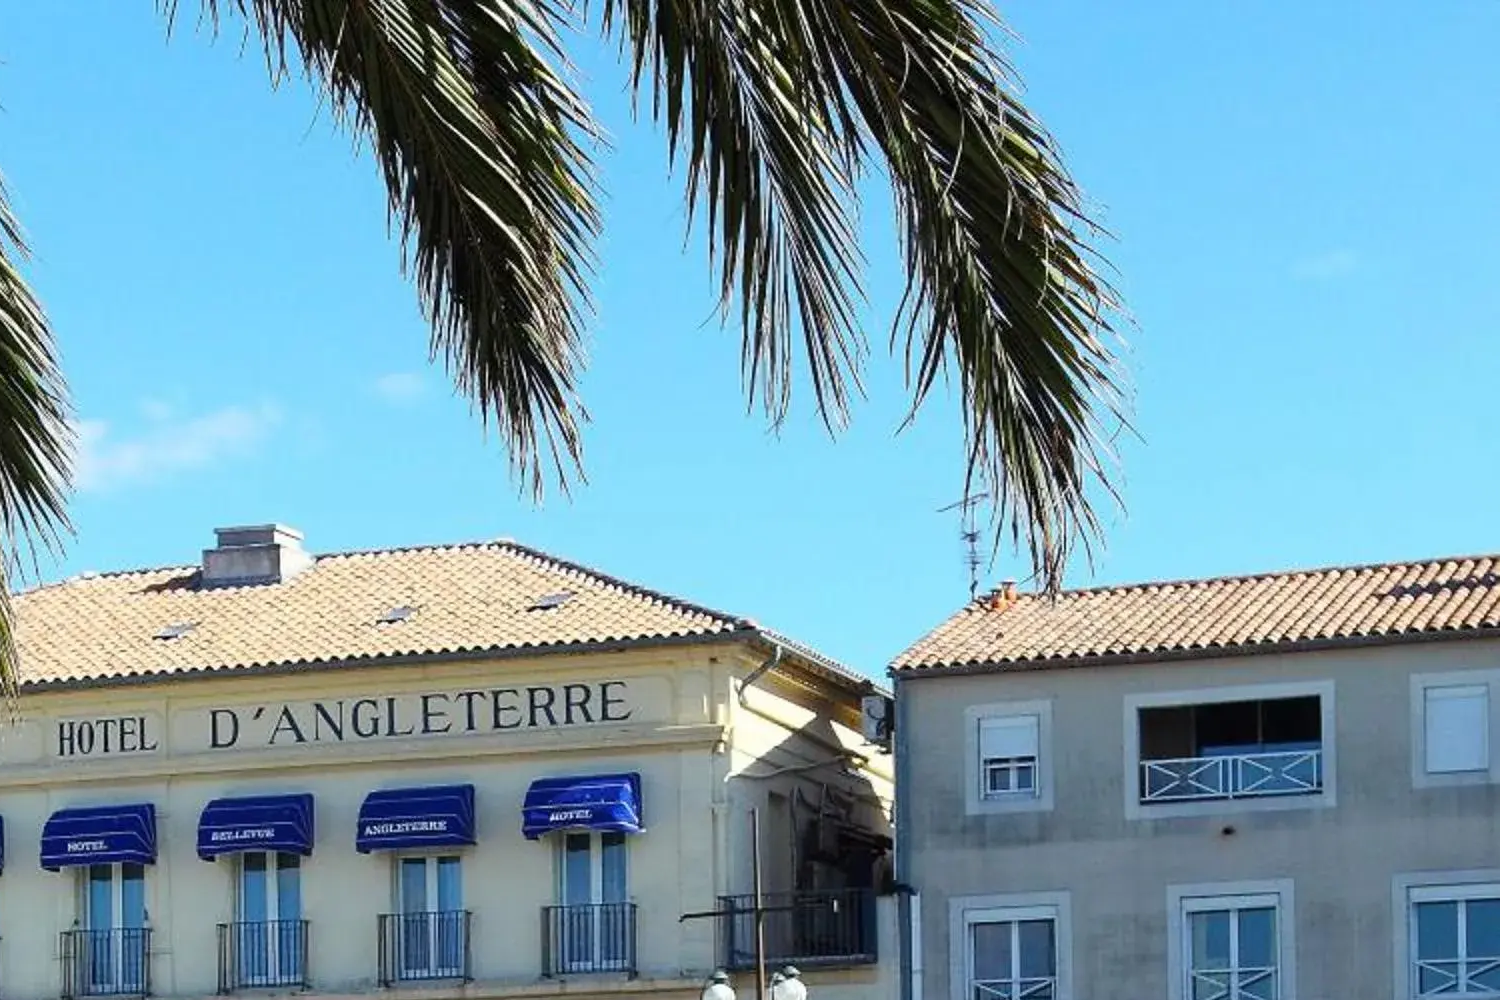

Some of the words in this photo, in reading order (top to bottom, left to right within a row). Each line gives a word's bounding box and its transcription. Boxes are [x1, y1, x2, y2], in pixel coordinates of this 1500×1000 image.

[209, 680, 632, 750] D'ANGLETERRE
[57, 716, 158, 756] HOTEL
[549, 808, 594, 822] HOTEL
[211, 827, 276, 842] BELLEVUE
[364, 819, 448, 836] ANGLETERRE
[67, 839, 109, 852] HOTEL
